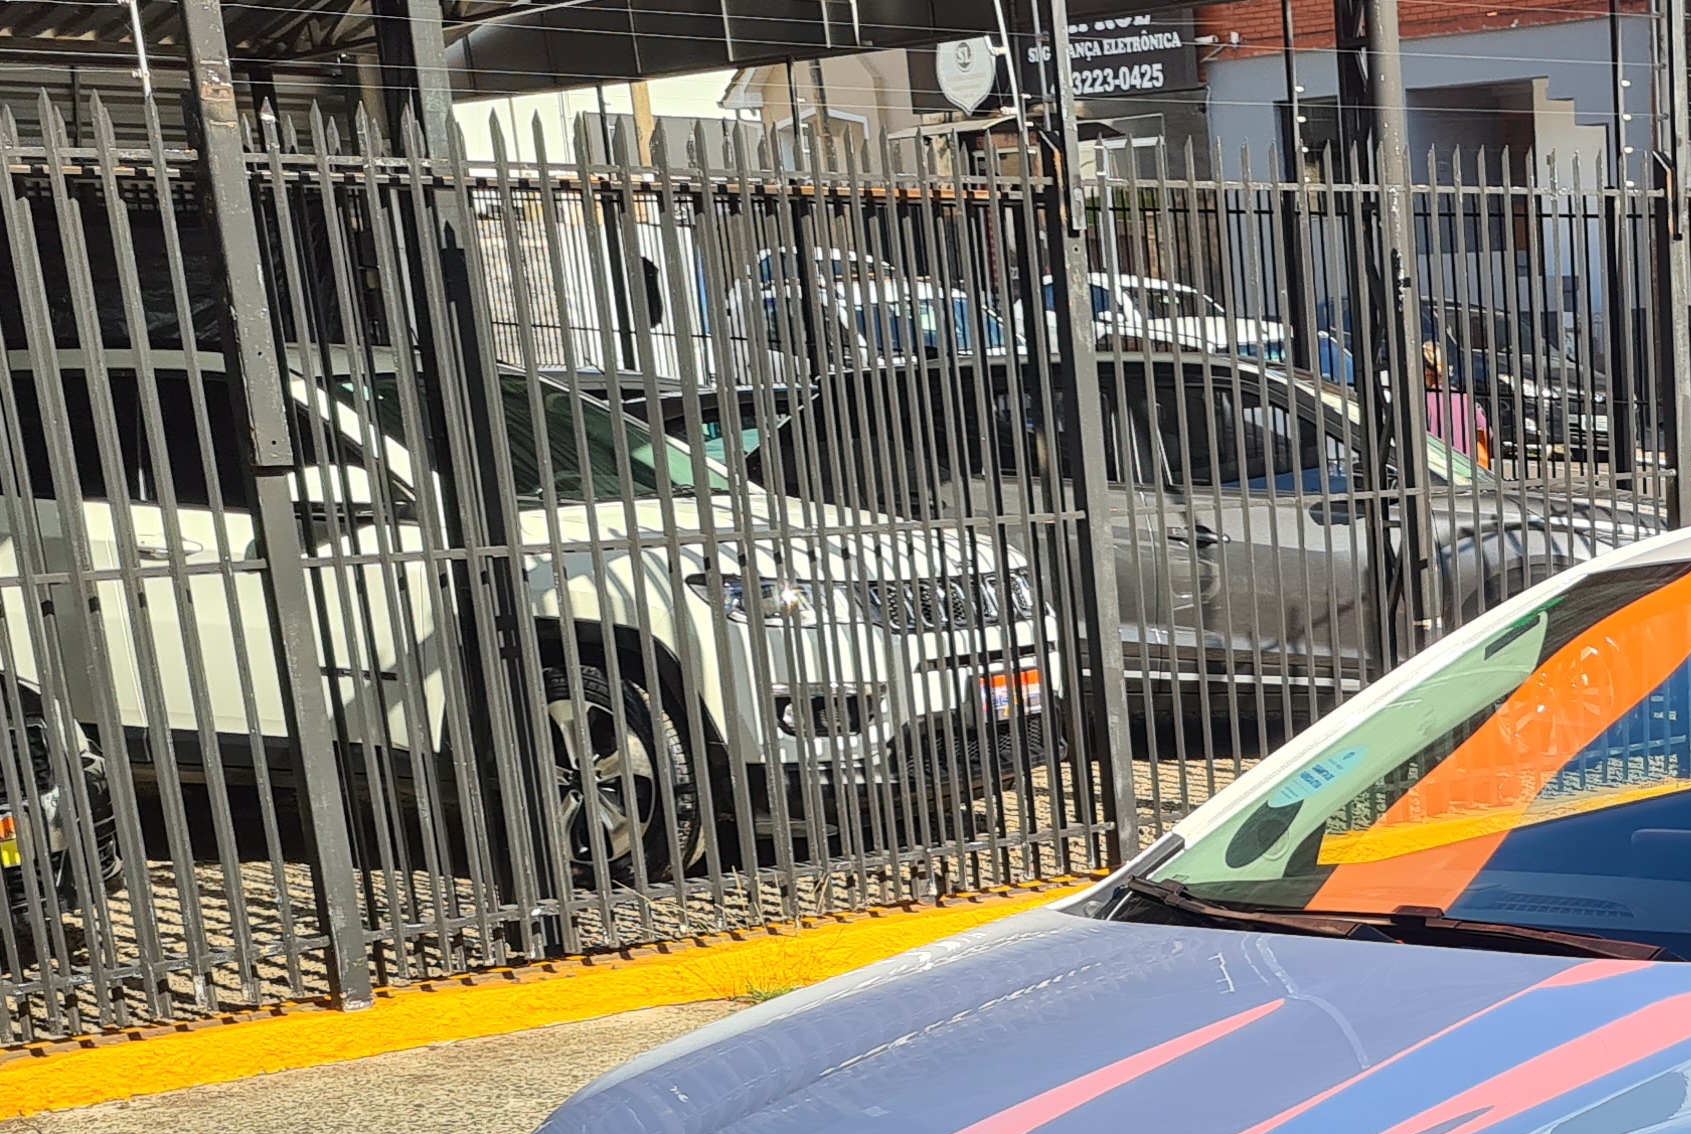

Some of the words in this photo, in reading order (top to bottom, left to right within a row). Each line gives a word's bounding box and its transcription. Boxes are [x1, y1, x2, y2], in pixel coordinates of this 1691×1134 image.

[1027, 41, 1102, 62] SGANÇA
[1103, 29, 1182, 55] ELETRÔNICA
[1072, 63, 1164, 96] 3223-0425
